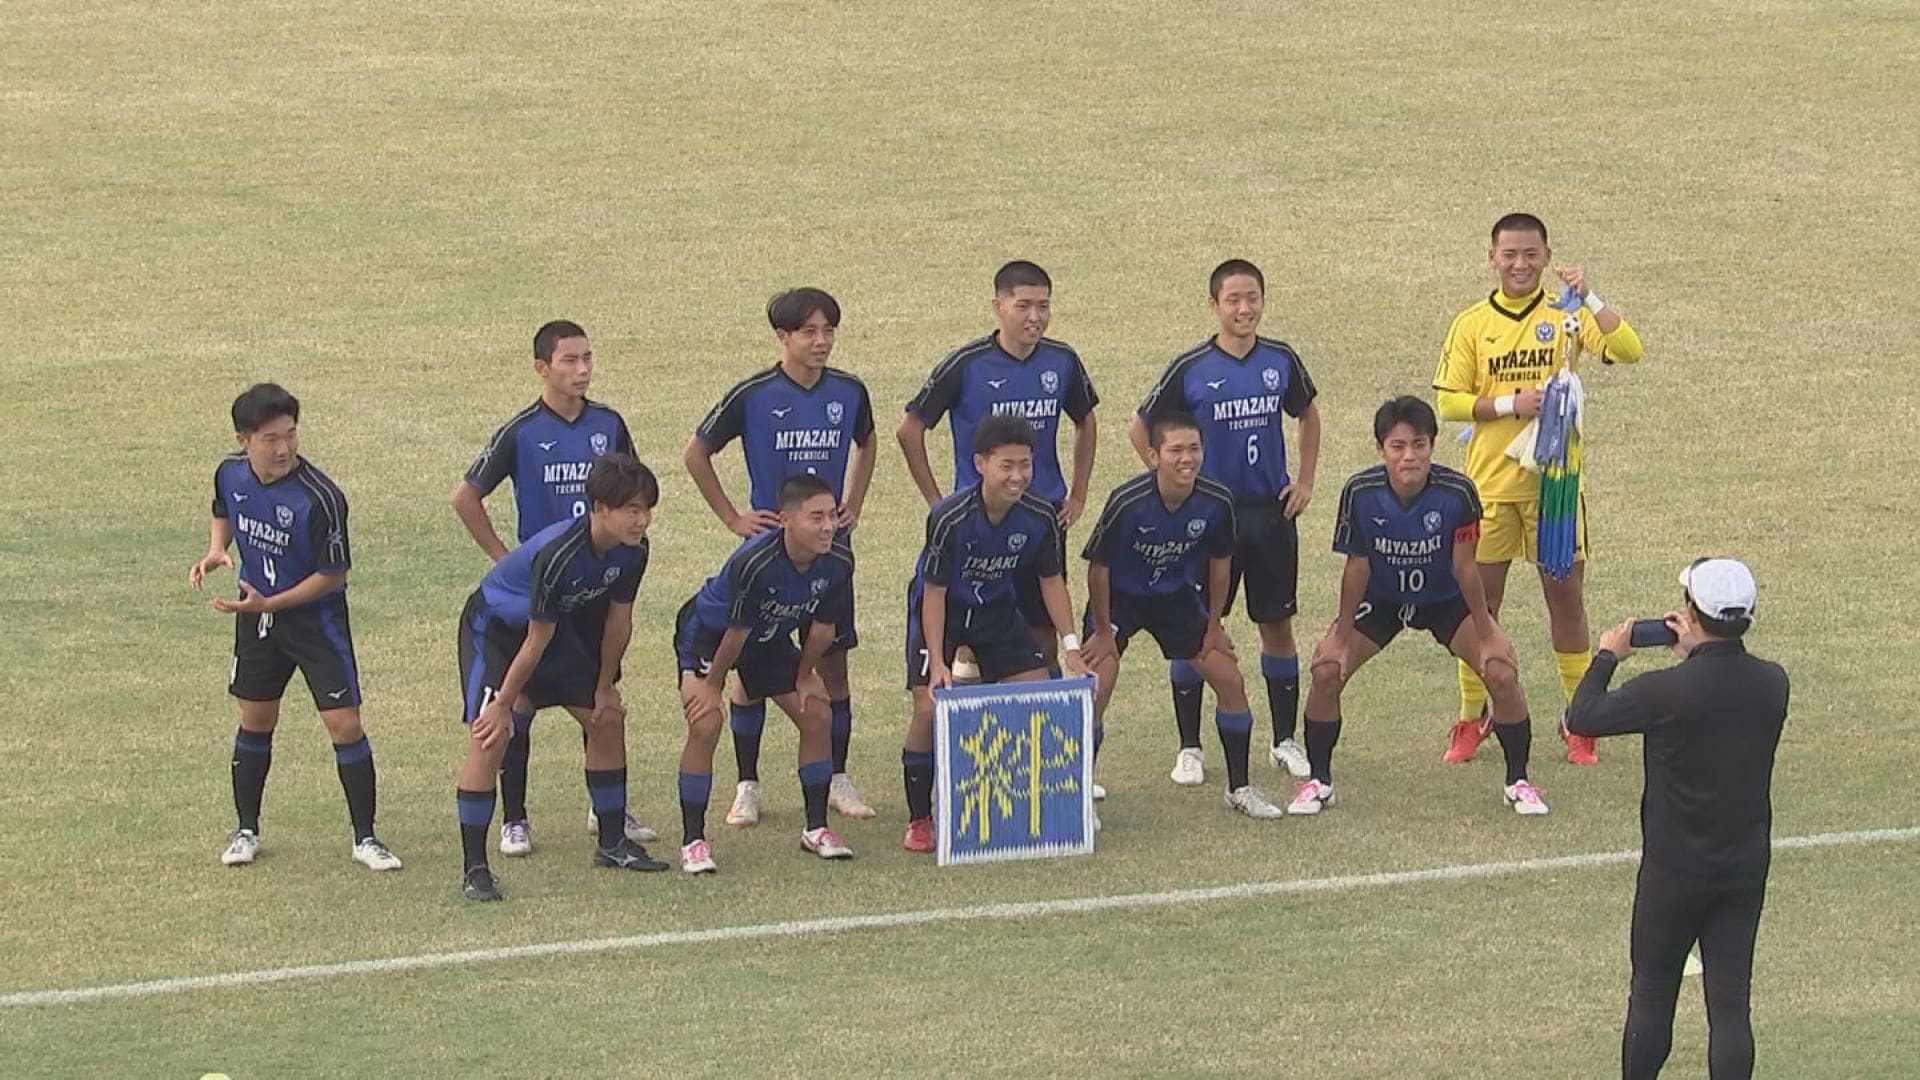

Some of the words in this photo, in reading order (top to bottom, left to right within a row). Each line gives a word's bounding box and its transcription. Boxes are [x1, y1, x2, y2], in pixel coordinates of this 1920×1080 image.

[1488, 348, 1554, 376] MYAZAKI
[1495, 371, 1541, 382] TECHNICAL
[992, 399, 1057, 418] MIYAZAKI
[1214, 395, 1280, 421] MIYAZAKI
[776, 430, 841, 450] MIYAZAKI
[1247, 434, 1259, 466] 6
[544, 462, 592, 482] MIYAZ
[1375, 535, 1441, 556] MIYAZAKI
[262, 555, 276, 586] 4
[1398, 569, 1424, 592] 10
[971, 581, 984, 604] 7
[919, 649, 928, 676] 7
